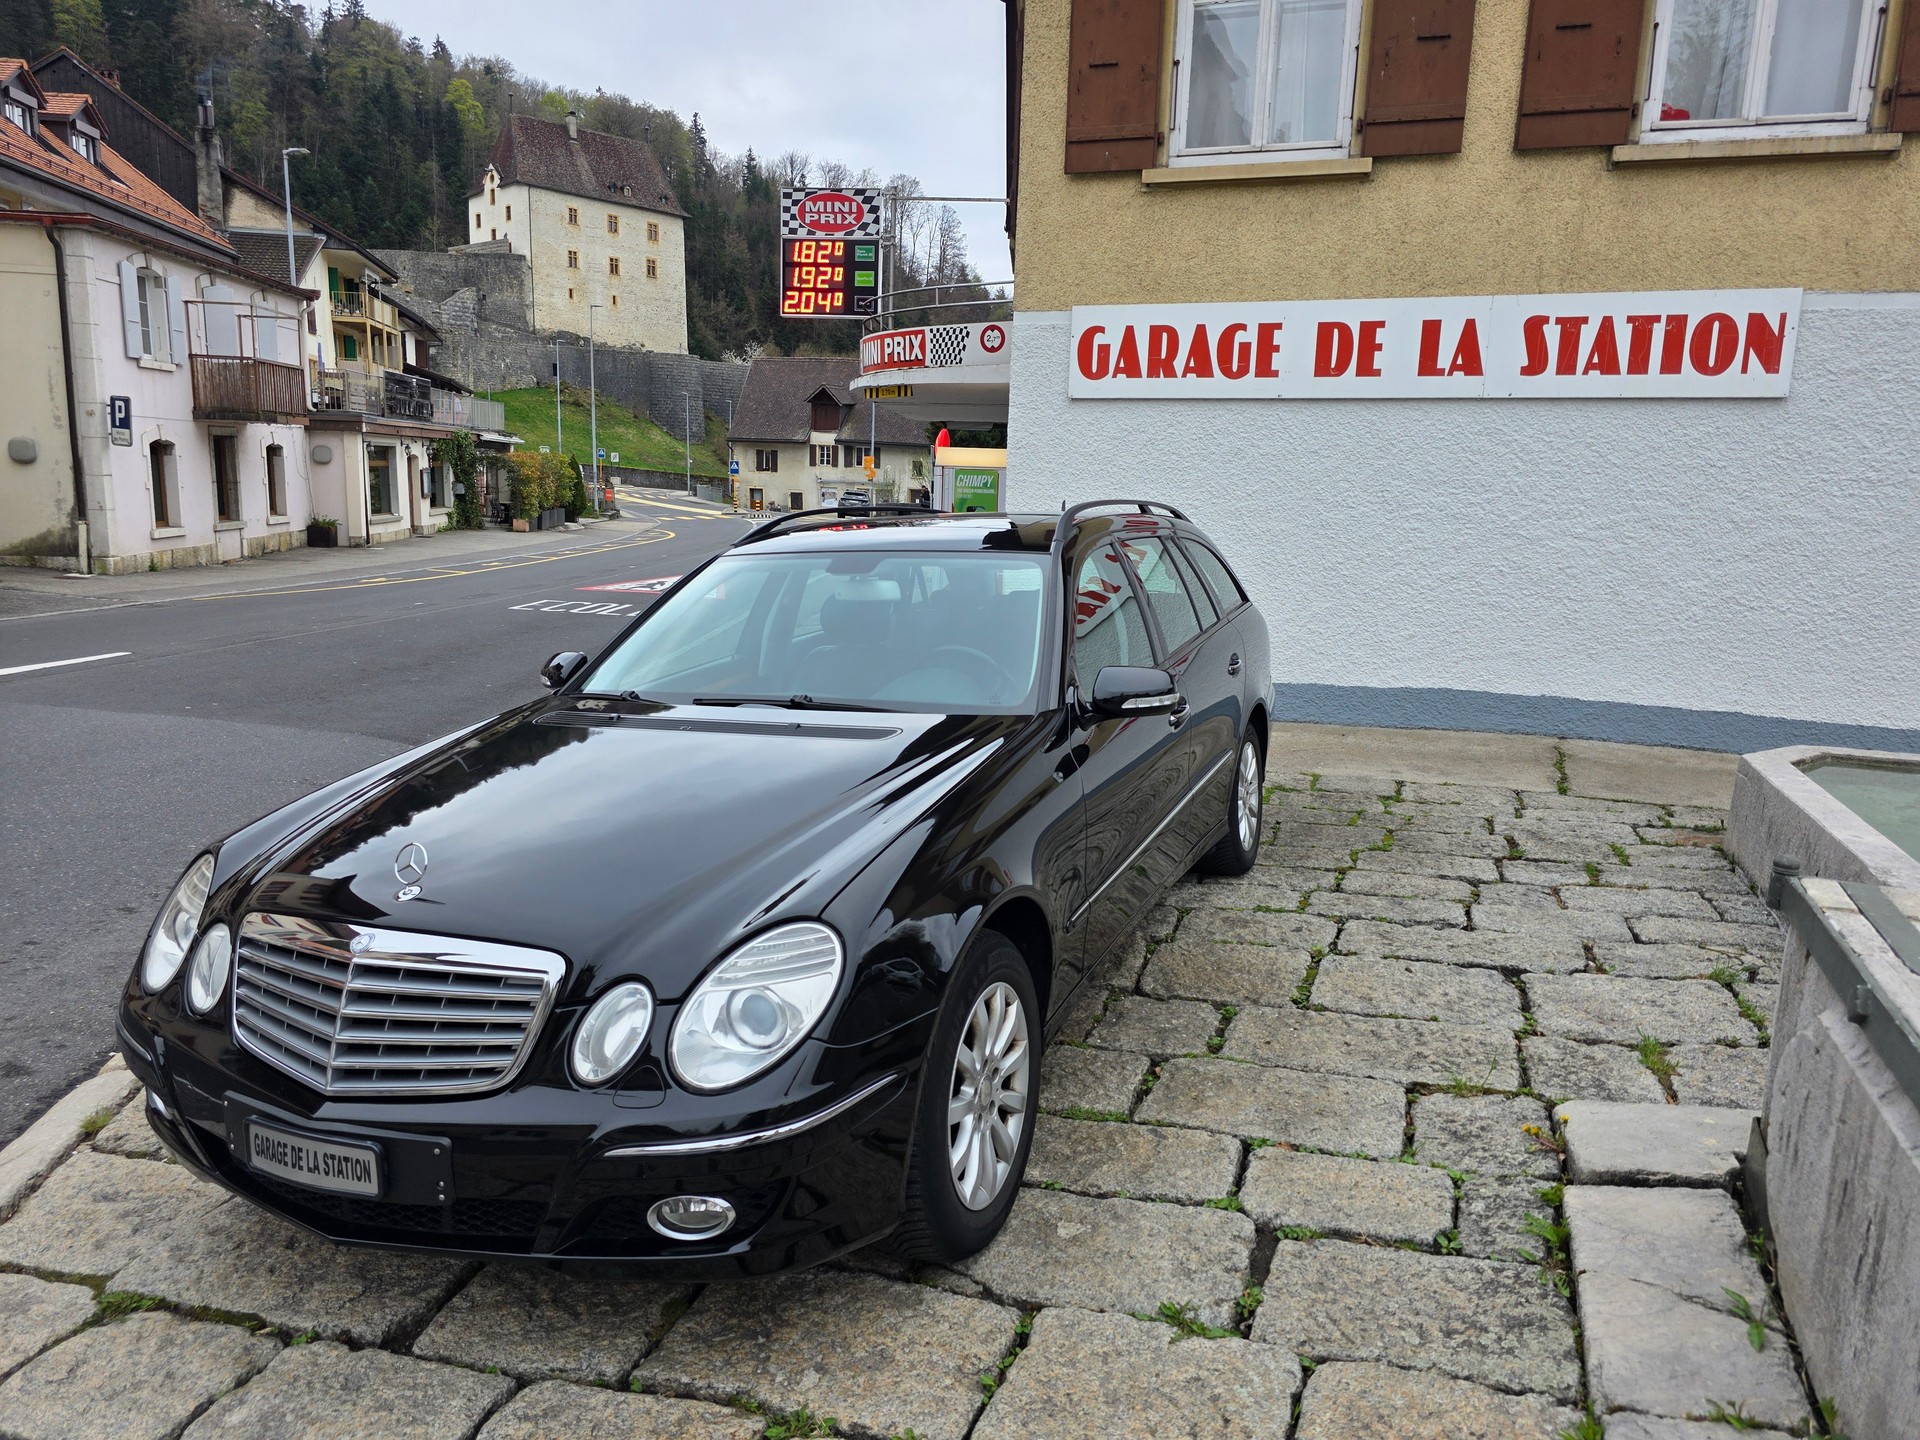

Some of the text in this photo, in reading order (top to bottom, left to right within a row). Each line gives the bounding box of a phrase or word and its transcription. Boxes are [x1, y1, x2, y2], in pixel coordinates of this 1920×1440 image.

[804, 201, 857, 213] MINI
[804, 213, 858, 225] PRIX
[863, 334, 924, 367] MINI PRIX
[1077, 312, 1788, 381] GARAGE DE LA STATION
[115, 400, 125, 426] P
[957, 474, 994, 487] CHIMPY
[254, 1132, 372, 1184] GARAGE DE LA STATION
